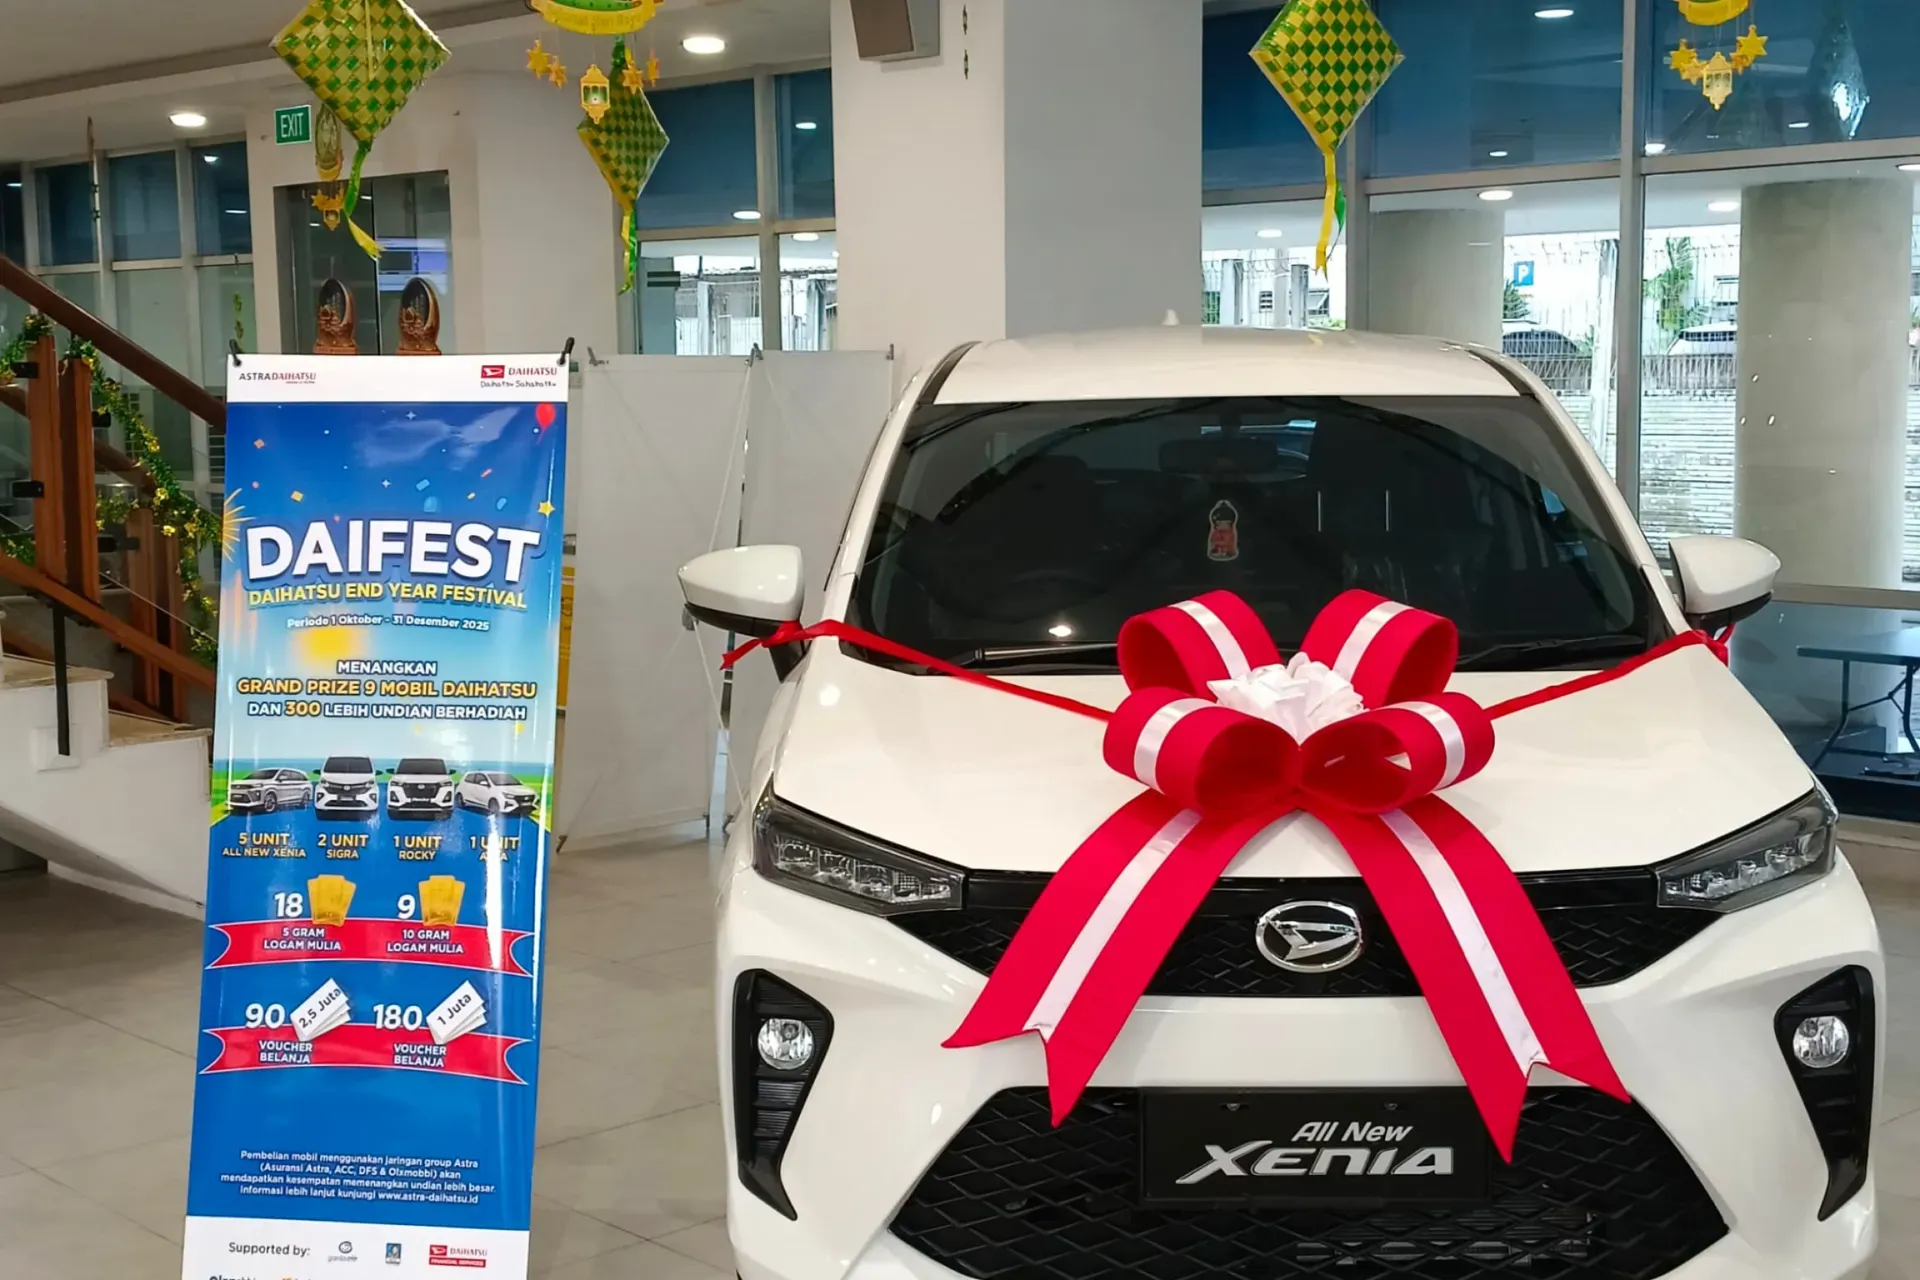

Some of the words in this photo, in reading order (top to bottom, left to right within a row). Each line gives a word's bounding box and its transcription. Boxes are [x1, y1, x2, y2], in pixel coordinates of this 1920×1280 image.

[281, 112, 304, 138] EXIT
[1518, 264, 1529, 284] P
[508, 367, 558, 376] DAIHATSU
[246, 519, 541, 584] DAIFEST
[249, 583, 341, 606] DAIHATSU
[345, 582, 383, 598] END
[388, 583, 437, 600] YEAR
[442, 585, 528, 610] FESTIVAL
[287, 615, 330, 629] Periode
[331, 616, 337, 626] 1
[338, 615, 383, 626] Oktober
[391, 616, 404, 626] 31
[406, 616, 459, 628] Desember
[461, 619, 490, 631] 2025
[337, 660, 437, 675] MENANGKAN
[237, 678, 302, 694] GRAND
[306, 679, 360, 695] PRIZE
[365, 680, 376, 695] 9
[380, 680, 438, 697] MOBIL
[443, 682, 537, 698] DAIHATSU
[248, 703, 281, 716] DAN
[284, 701, 321, 716] 300
[324, 703, 368, 718] LEBIH
[372, 704, 432, 718] UNDIAN
[435, 705, 527, 720] BERHADIAH
[238, 833, 248, 845] 5
[252, 833, 290, 846] UNIT
[318, 834, 327, 847] 2
[332, 834, 369, 848] UNIT
[393, 836, 400, 848] 1
[403, 836, 442, 849] UNIT
[470, 836, 476, 849] 1
[222, 847, 242, 857] ALL
[244, 847, 271, 857] NEW
[272, 848, 307, 858] XENIA
[326, 849, 359, 860] SIGRA
[398, 850, 436, 861] ROCKY
[274, 892, 304, 918] 18
[397, 894, 416, 920] 9
[282, 927, 290, 937] 5
[293, 927, 325, 938] GRAM
[402, 929, 415, 940] 10
[417, 930, 450, 941] GRAM
[263, 939, 305, 951] LOGAM
[307, 940, 342, 952] MULIA
[387, 942, 427, 954] LOGAM
[430, 943, 464, 955] MULIA
[298, 1006, 318, 1029] 2,5
[314, 986, 342, 1012] Juta
[436, 1013, 446, 1026] 1
[447, 992, 472, 1018] Juta
[245, 1004, 285, 1029] 90
[373, 1004, 423, 1031] 180
[259, 1040, 313, 1052] VOUCHER
[393, 1043, 447, 1055] VOUCHER
[259, 1052, 311, 1064] BELANJA
[394, 1055, 445, 1067] BELANJA
[1291, 1121, 1339, 1142] All
[1341, 1121, 1413, 1142] New
[240, 1150, 289, 1161] Pembelian
[291, 1152, 318, 1161] mobil
[320, 1153, 383, 1165] menggunakan
[385, 1155, 422, 1167] jaringan
[424, 1159, 452, 1170] group
[454, 1158, 478, 1168] Astra
[260, 1162, 303, 1172] (Asuransi
[305, 1164, 332, 1174] Astra,
[334, 1165, 357, 1176] ACC,
[359, 1166, 378, 1175] DFS
[379, 1167, 387, 1176] &
[439, 1170, 461, 1179] akan
[221, 1174, 284, 1185] mendapatkan
[286, 1175, 341, 1187] kesempatan
[342, 1178, 408, 1190] memenangkan
[410, 1181, 442, 1191] undian
[444, 1182, 466, 1192] lebih
[468, 1183, 496, 1193] besar.
[240, 1185, 283, 1195] Informasi
[285, 1186, 308, 1196] lebih
[310, 1187, 335, 1199] lanjut
[337, 1188, 375, 1201] kunjungi
[378, 1191, 479, 1204] www.astra-daihatsu.id
[228, 1241, 290, 1256] Supported
[292, 1244, 311, 1258] by:
